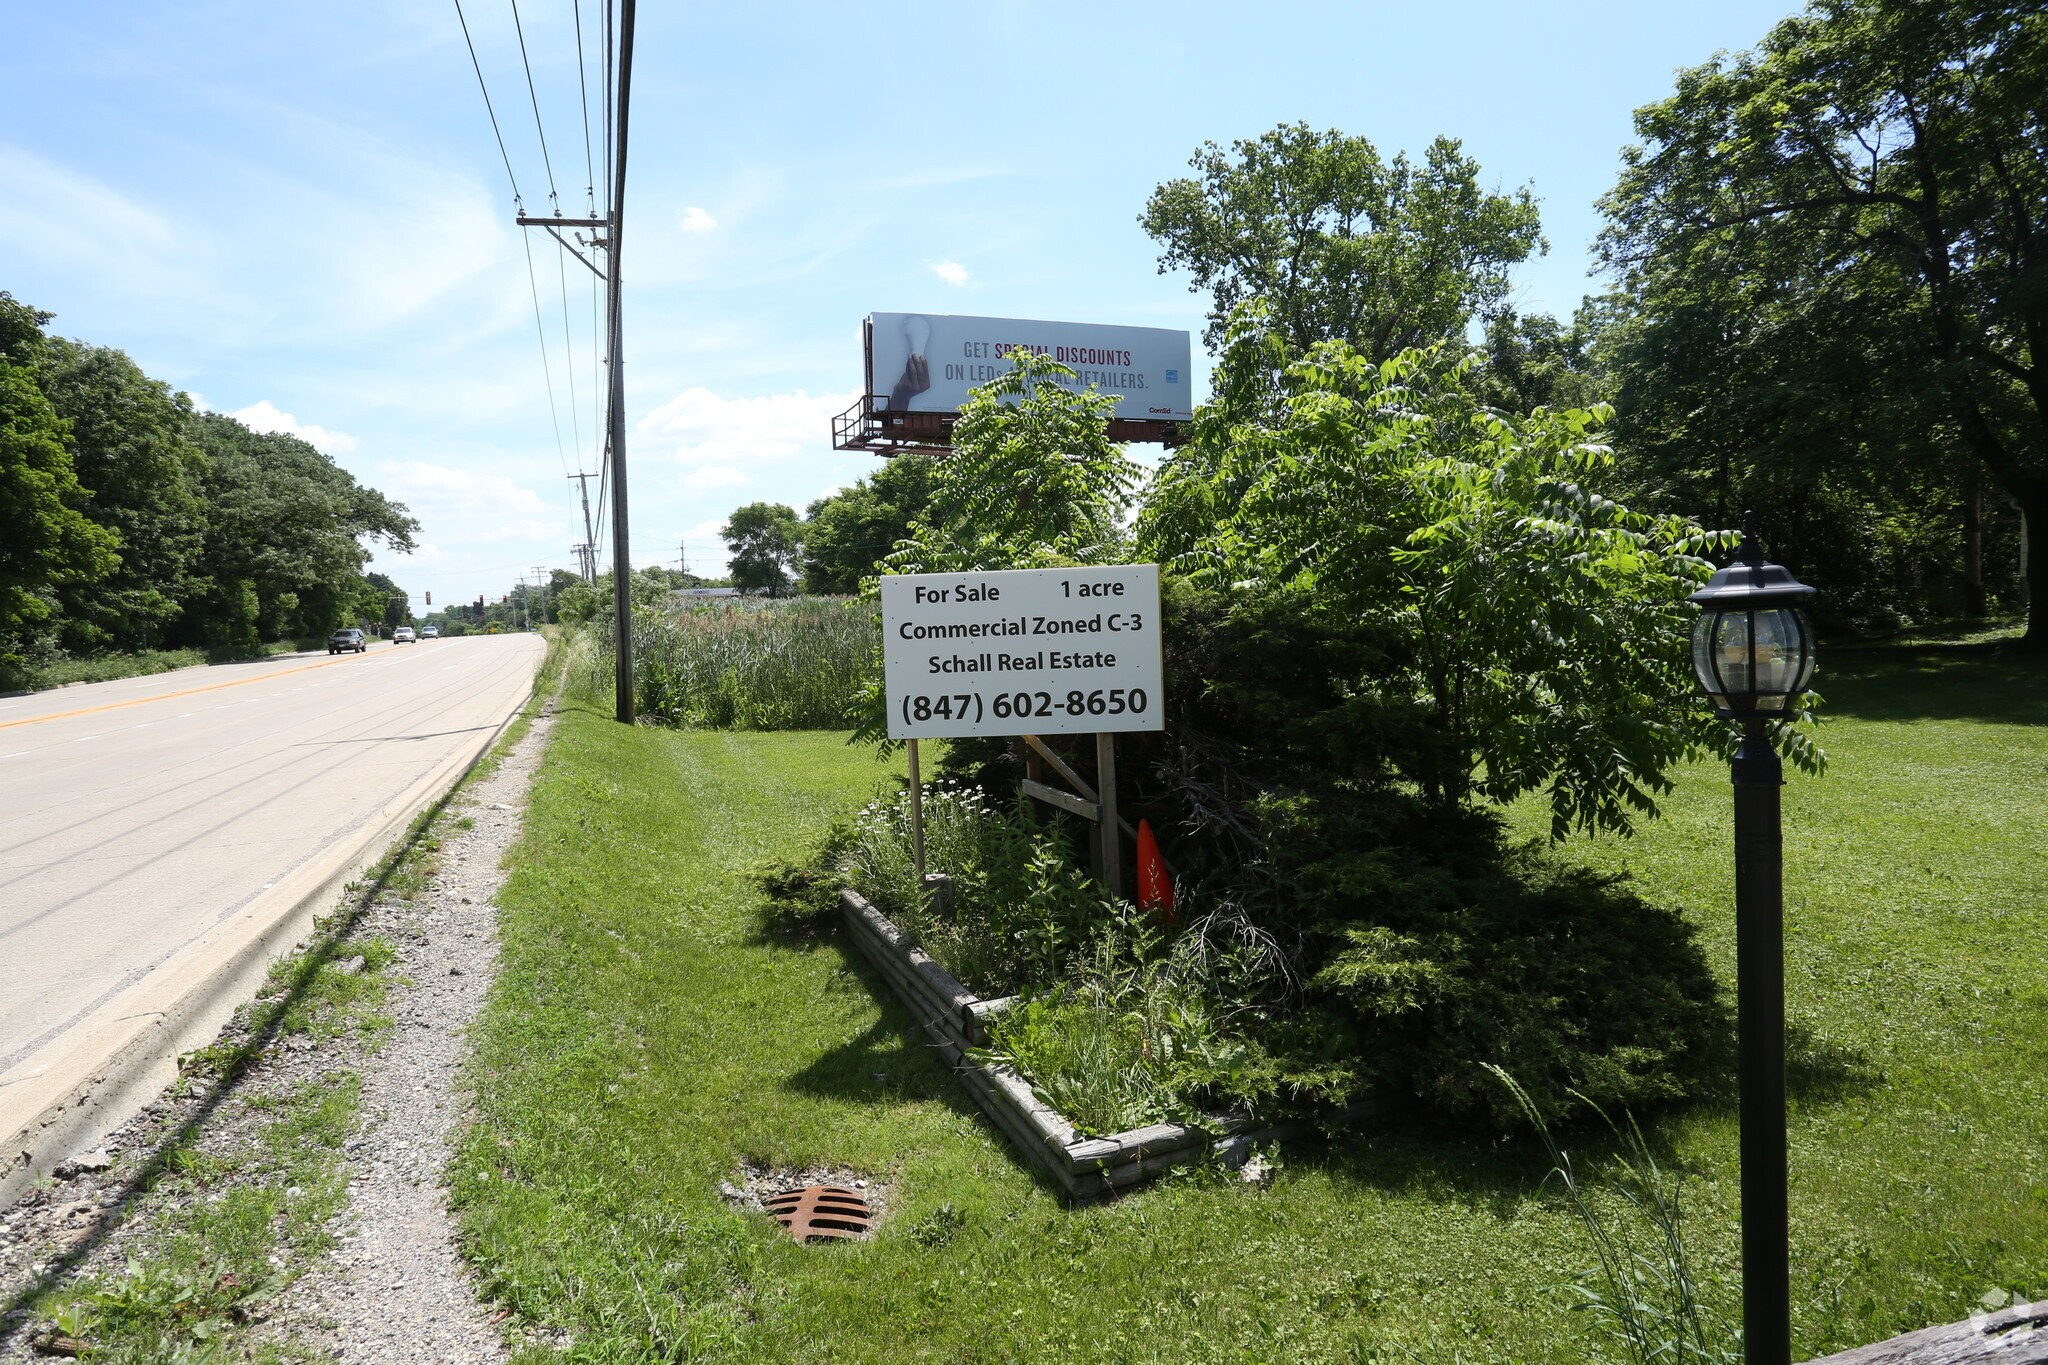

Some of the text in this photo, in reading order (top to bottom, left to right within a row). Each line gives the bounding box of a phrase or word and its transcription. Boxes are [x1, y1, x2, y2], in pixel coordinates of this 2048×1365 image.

[964, 341, 1131, 367] GET SPIA DISCOUNTS
[945, 363, 964, 380] ON
[970, 364, 1003, 381] LEDs
[1076, 370, 1149, 390] RETAILERS.
[915, 580, 1125, 604] For Sale 1 acre
[899, 613, 1143, 640] Commercial Zoned C-3
[928, 651, 1116, 674] Schall Real Estate
[902, 688, 1148, 726] (847) 602-8650
